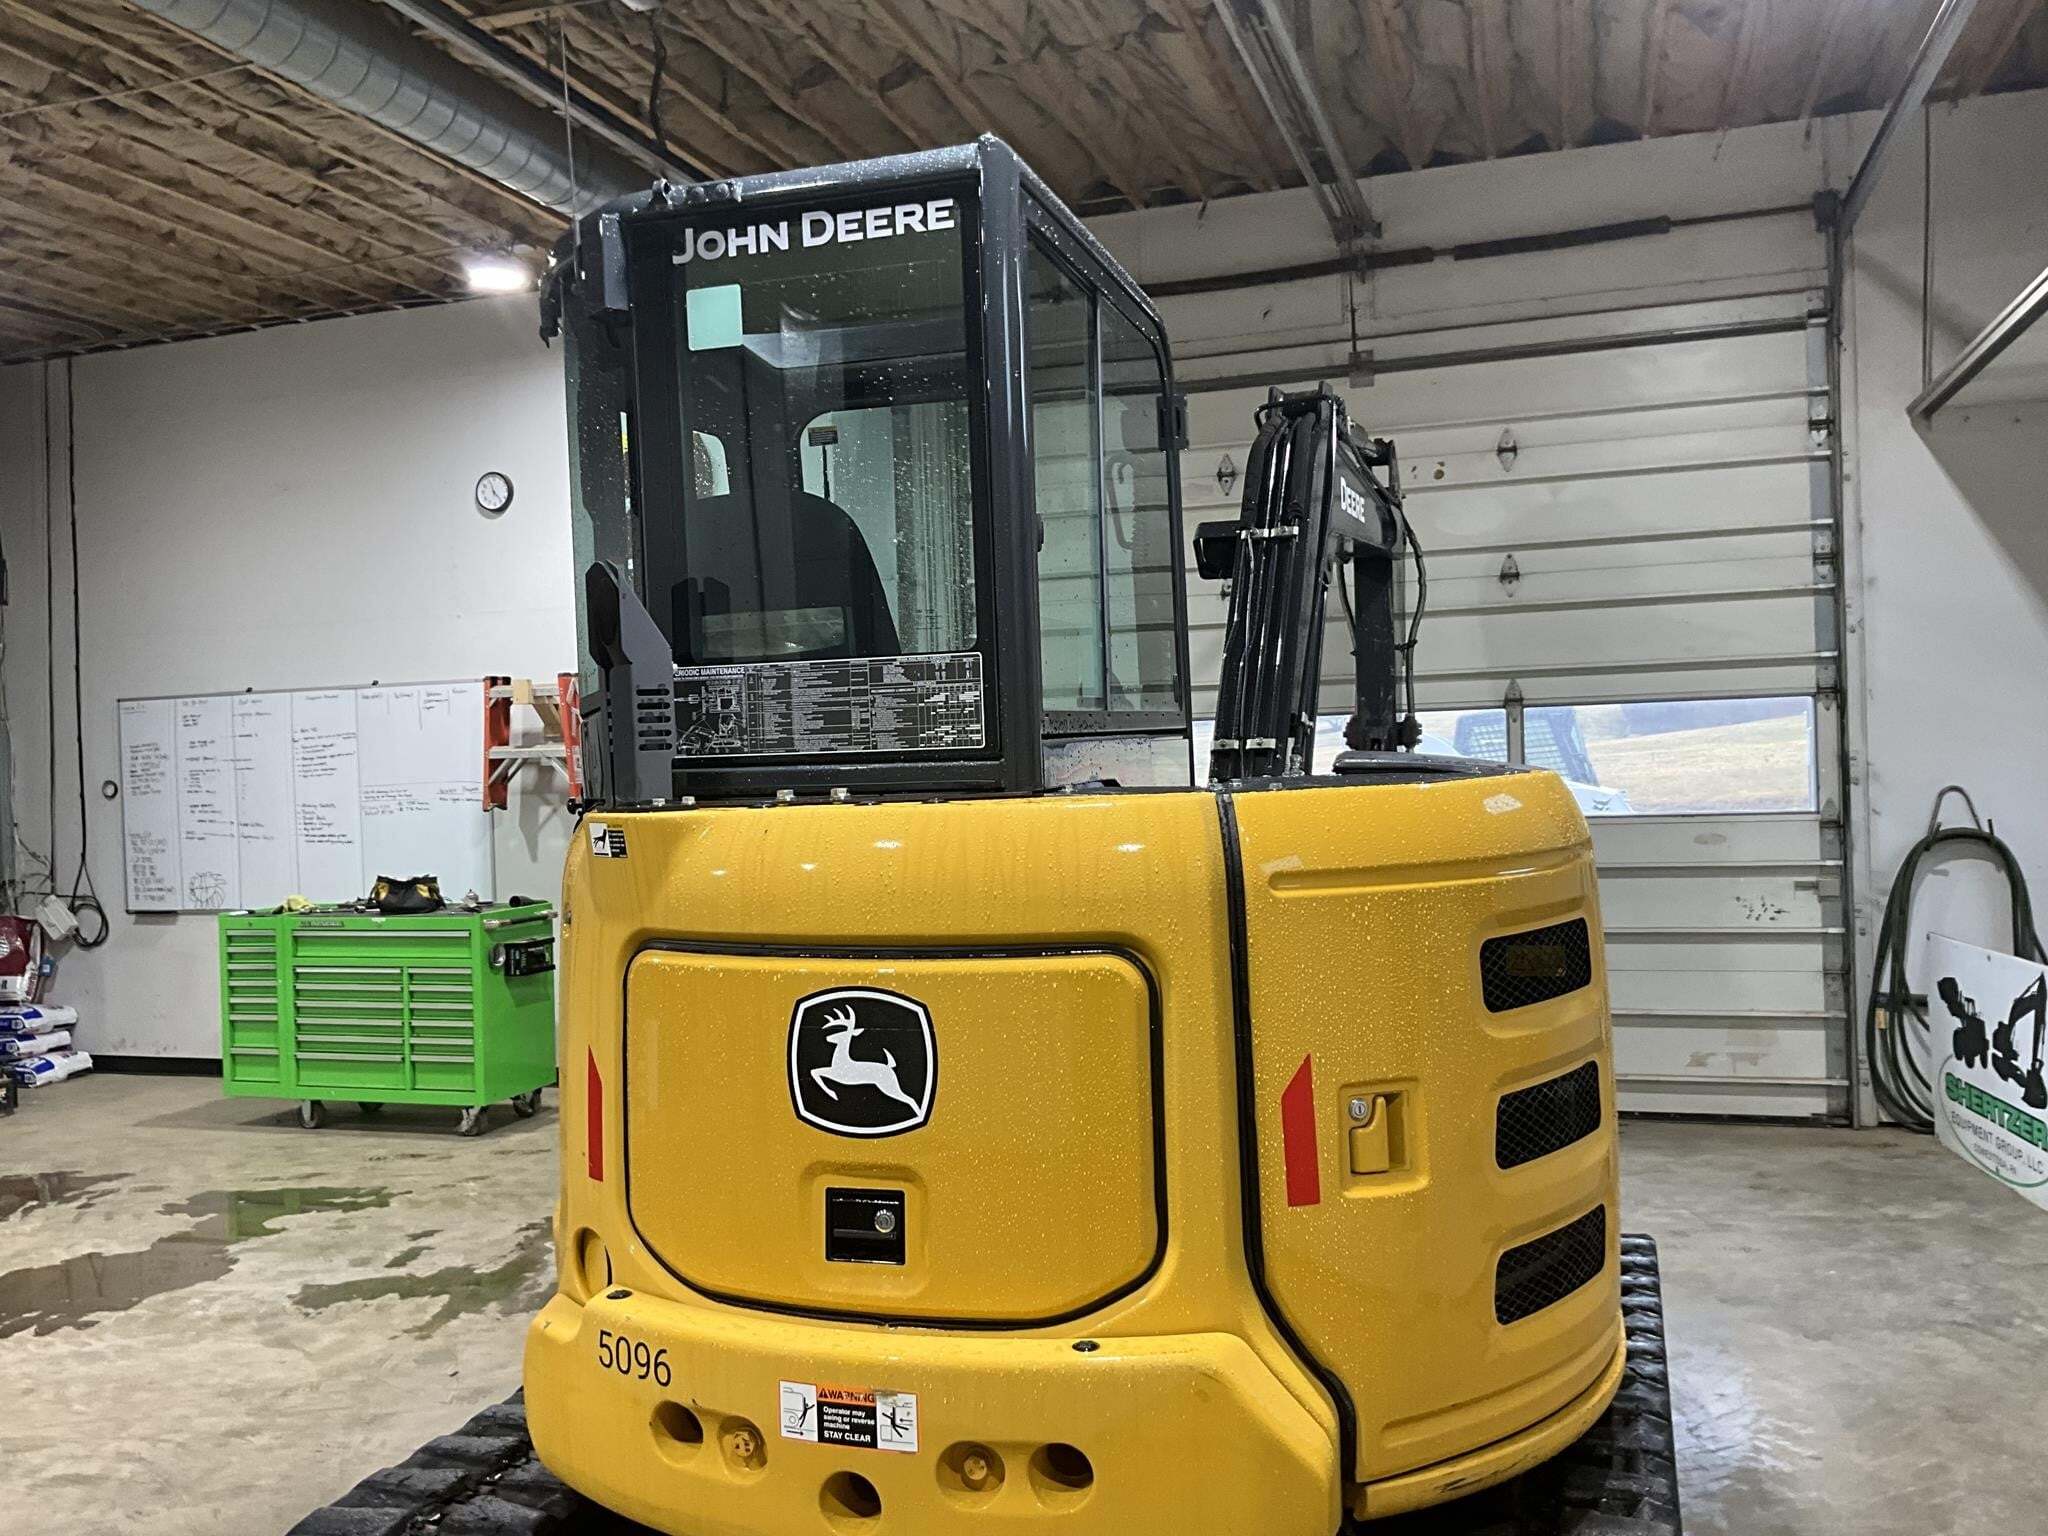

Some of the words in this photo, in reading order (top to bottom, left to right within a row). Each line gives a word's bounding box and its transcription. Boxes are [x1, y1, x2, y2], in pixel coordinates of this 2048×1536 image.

[672, 221, 789, 265] JOHN
[801, 198, 955, 248] DEERE
[1341, 476, 1365, 524] DEERE
[701, 666, 745, 676] MAINTENANCE
[598, 1329, 672, 1387] 5096
[823, 1406, 851, 1415] Operator
[851, 1410, 866, 1418] may
[823, 1415, 842, 1423] swing
[823, 1421, 850, 1430] machine
[824, 1430, 843, 1439] STAY
[844, 1432, 871, 1443] CLEAR
